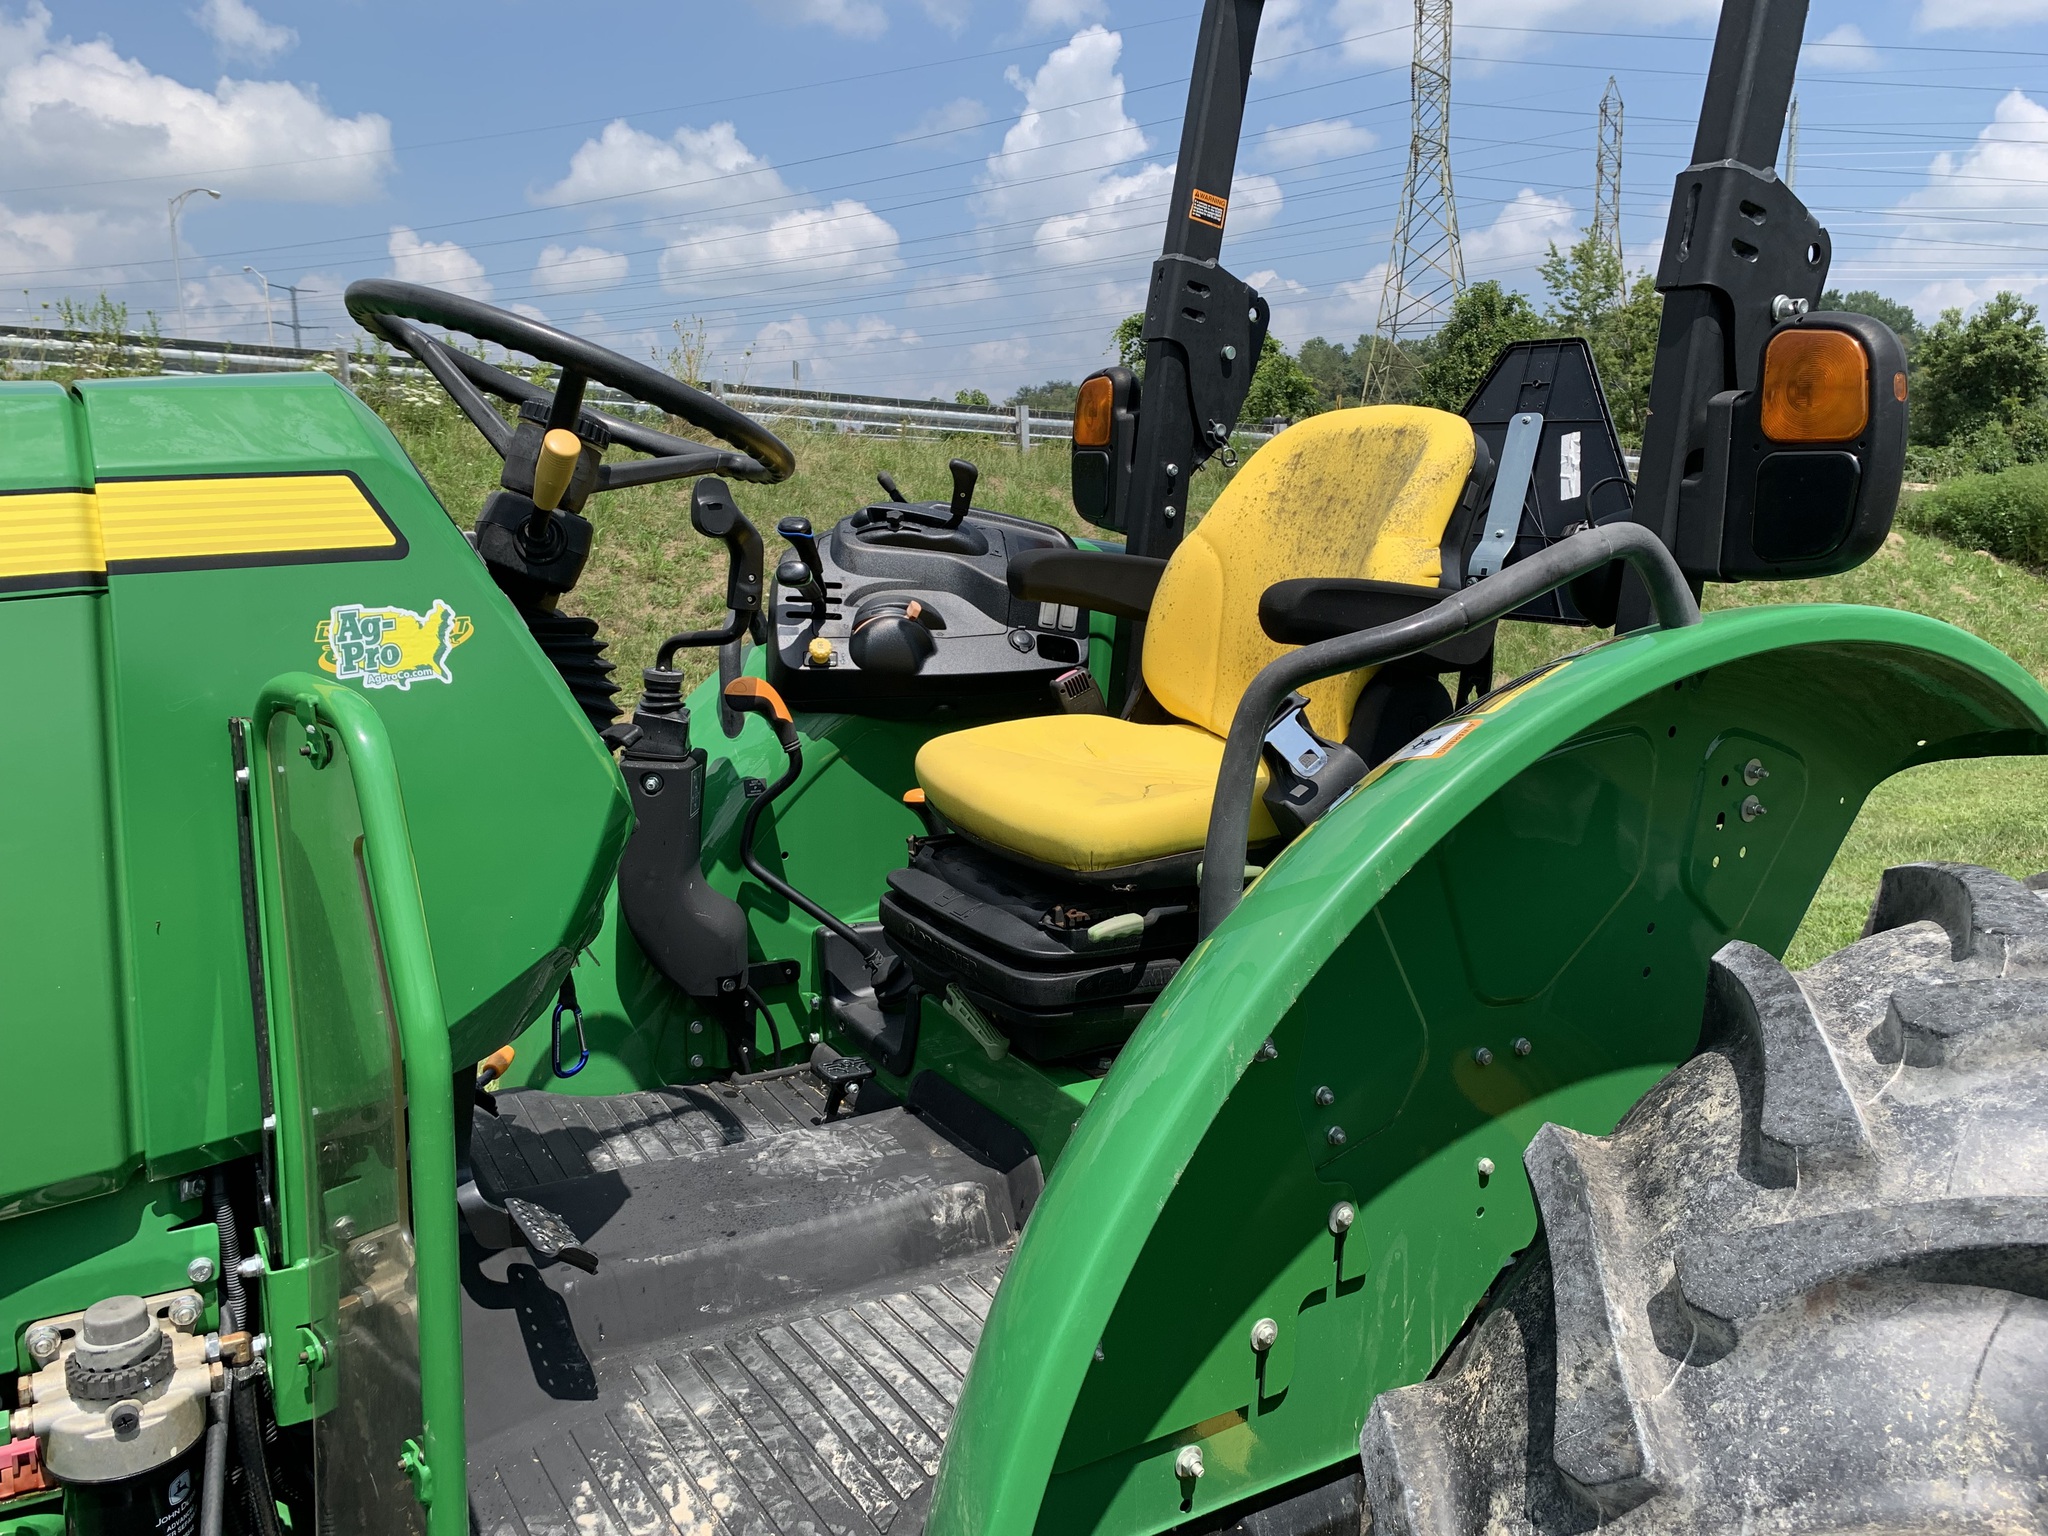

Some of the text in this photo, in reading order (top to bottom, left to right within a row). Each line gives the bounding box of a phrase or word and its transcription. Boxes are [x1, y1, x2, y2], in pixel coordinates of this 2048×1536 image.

[1199, 191, 1226, 207] WARNING
[337, 609, 397, 646] Ag-
[339, 640, 403, 676] Pro
[367, 668, 433, 685] AgProCo.com
[155, 1507, 181, 1528] JOHN
